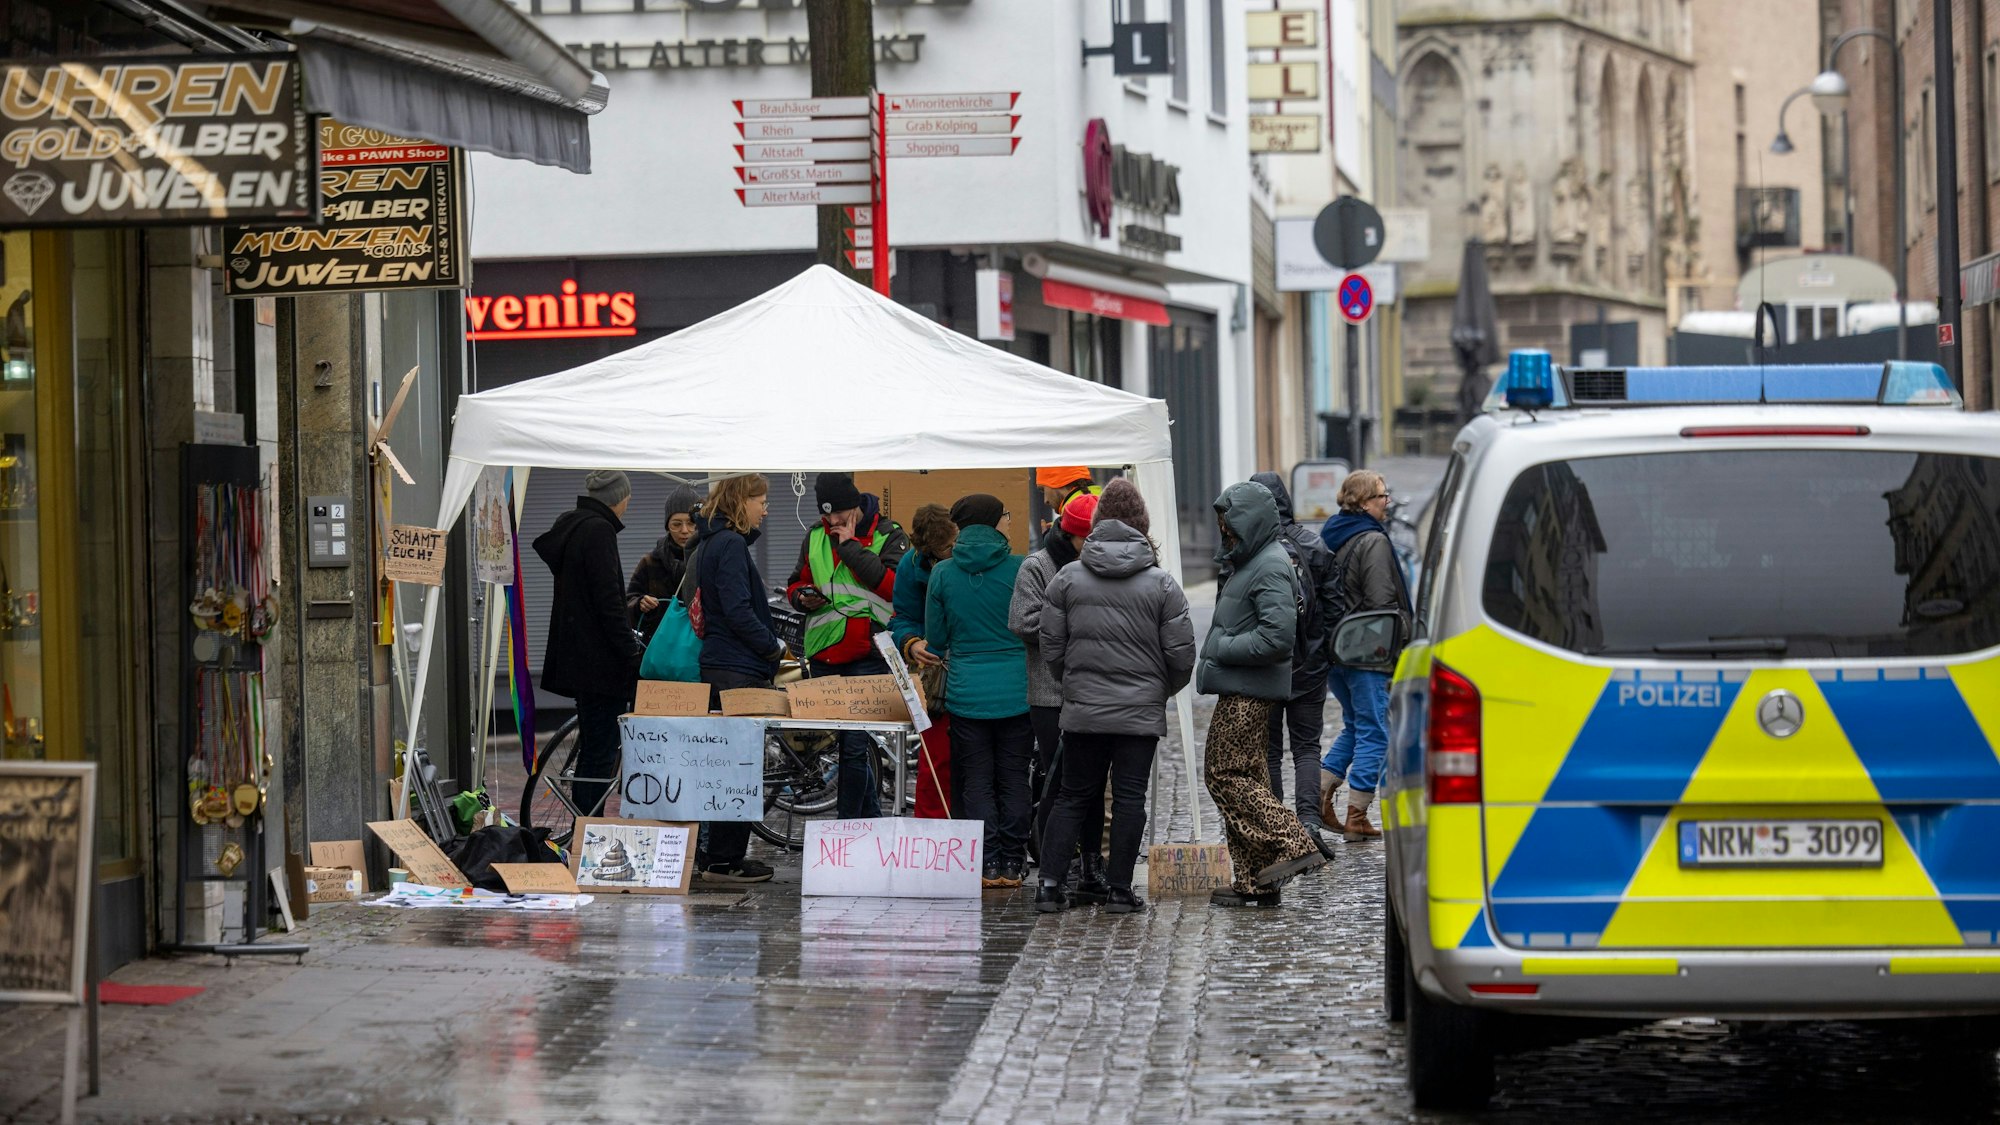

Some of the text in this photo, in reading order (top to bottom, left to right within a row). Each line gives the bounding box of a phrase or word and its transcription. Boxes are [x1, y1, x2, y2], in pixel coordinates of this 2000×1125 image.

[647, 38, 765, 68] ALTER
[788, 34, 926, 66] MKT
[1132, 31, 1152, 65] L
[0, 61, 289, 124] UHREN
[760, 103, 821, 114] Brauhäuser
[905, 97, 993, 109] Minoritenkirche
[762, 125, 794, 136] Rhein
[906, 119, 978, 133] Grab Kolping
[321, 153, 345, 162] ike
[359, 151, 403, 160] PAWN
[407, 149, 446, 158] Shop
[761, 147, 804, 158] Altstadt
[906, 142, 960, 156] Shopping
[761, 167, 842, 180] Groß St. Martin
[61, 162, 292, 214] JUWELEN
[320, 166, 429, 198] REN
[436, 168, 447, 235] VERKAUF
[762, 190, 821, 202] Alter Markt
[231, 225, 433, 257] MÜNZEN
[371, 243, 424, 258] COINS
[235, 258, 434, 290] JUWELEN
[314, 360, 333, 387] 2
[335, 506, 341, 517] 2
[821, 687, 843, 695] mit
[845, 685, 865, 694] der
[1619, 684, 1721, 707] POLIZEI
[823, 699, 846, 707] Das
[849, 697, 870, 706] sind
[872, 697, 889, 706] die
[624, 724, 729, 745] Nazis machen
[625, 772, 682, 805] CDU
[695, 779, 722, 790] was
[820, 821, 873, 833] SCHON
[1698, 825, 1879, 857] NRW 5-3099
